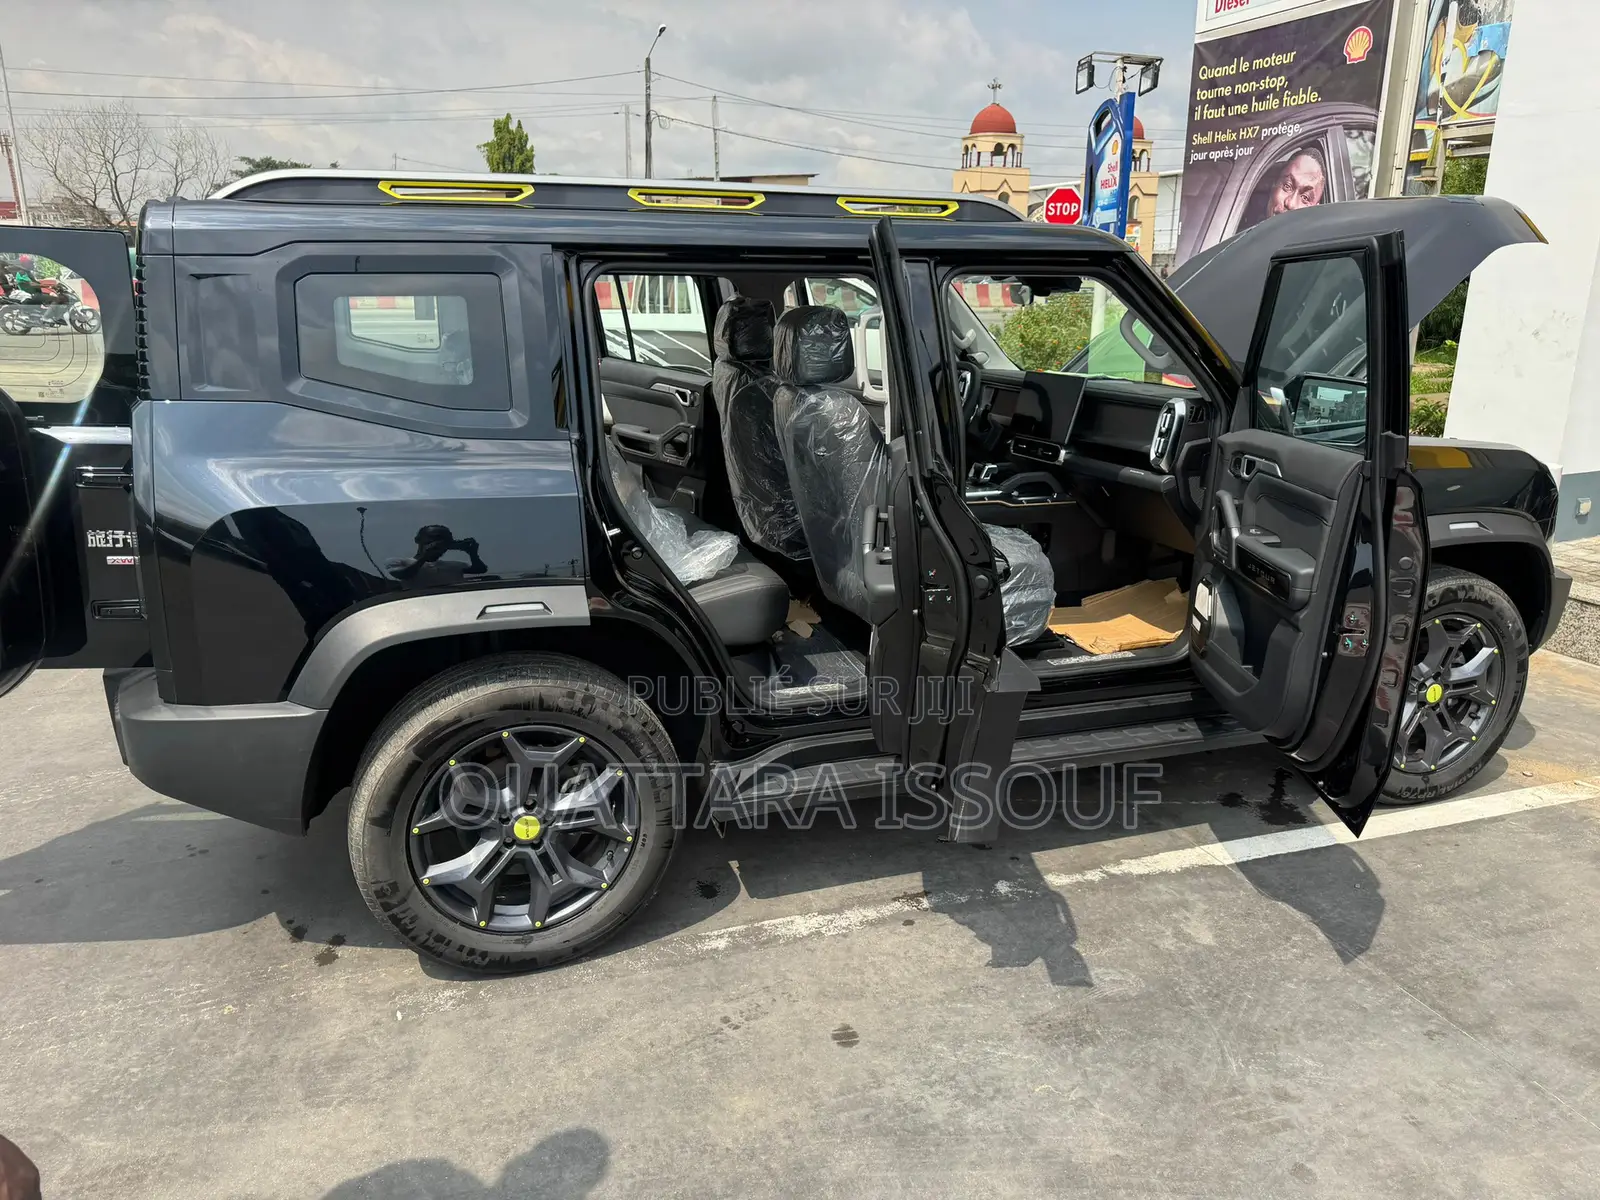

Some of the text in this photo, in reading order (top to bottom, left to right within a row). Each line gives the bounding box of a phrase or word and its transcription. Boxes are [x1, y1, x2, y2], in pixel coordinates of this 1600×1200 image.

[1198, 51, 1296, 80] Quand le moteur
[1196, 75, 1288, 101] tourne non-stop,
[1194, 86, 1322, 120] il faut une huile fiable.
[1192, 122, 1303, 145] Shell Helix HX7 protège,
[1189, 145, 1254, 164] jour après jour
[1108, 161, 1118, 173] Shell
[1101, 174, 1117, 189] HELIX
[1047, 202, 1079, 216] STOP
